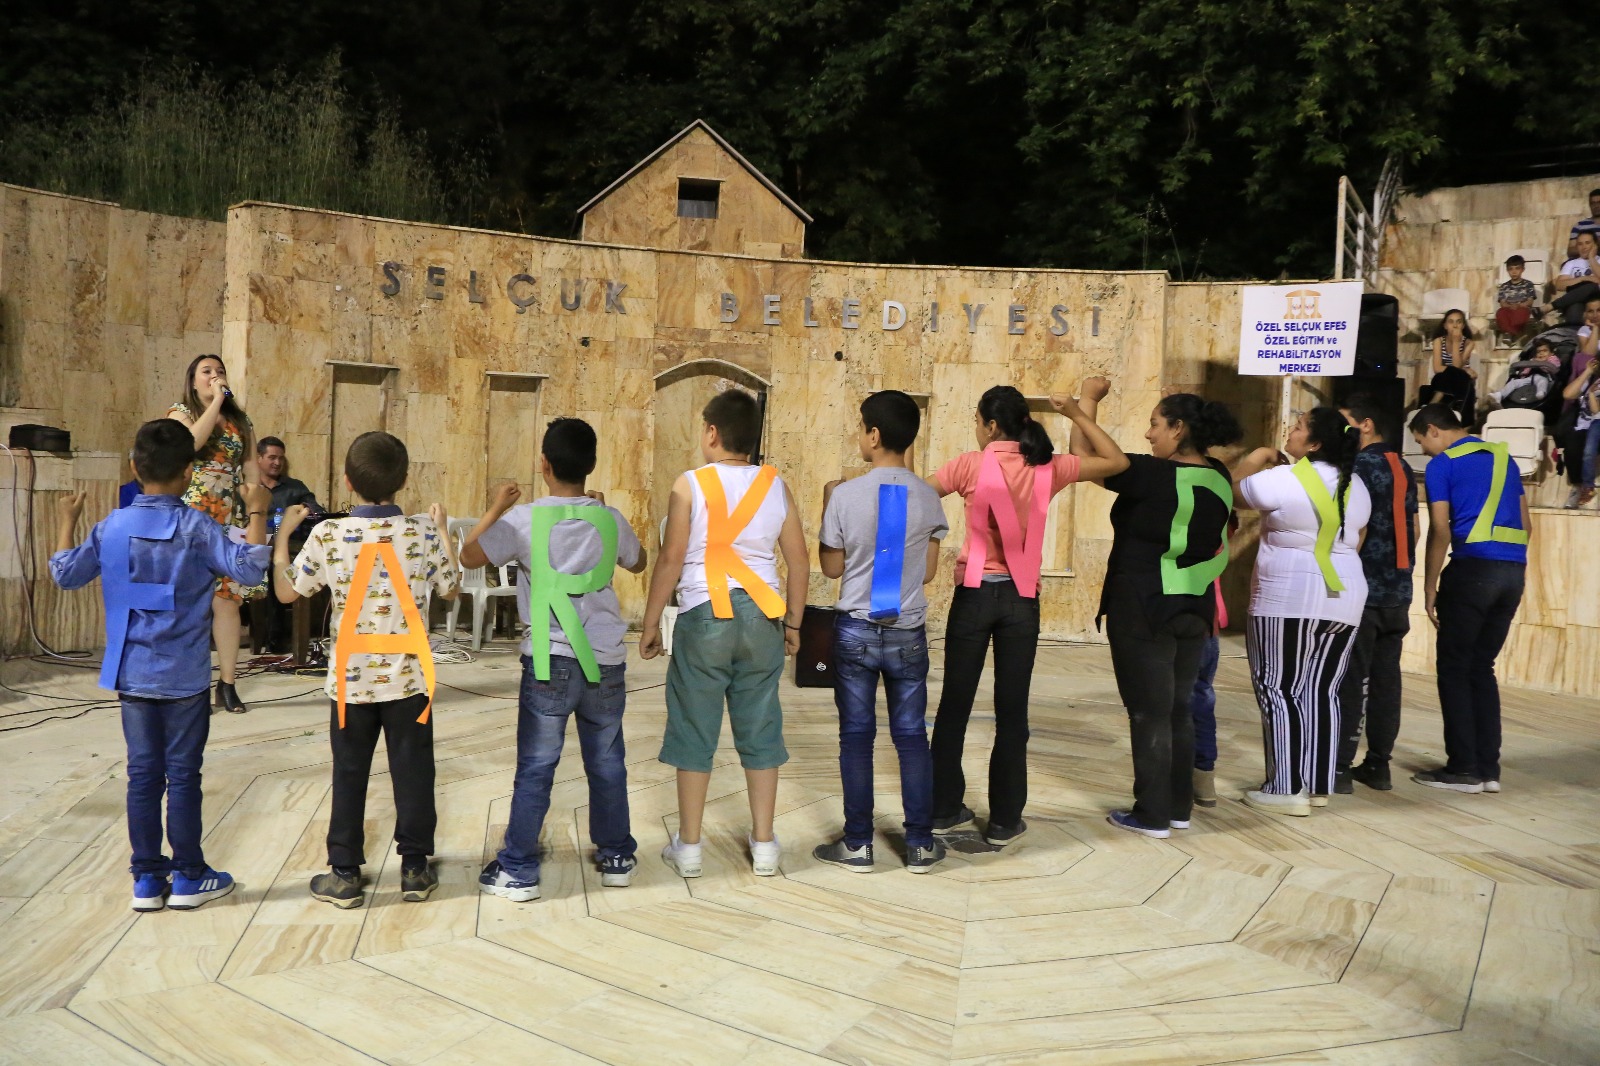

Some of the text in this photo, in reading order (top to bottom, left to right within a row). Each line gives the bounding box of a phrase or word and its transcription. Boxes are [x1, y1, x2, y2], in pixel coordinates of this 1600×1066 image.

[380, 260, 627, 315] SELÇUK
[1255, 321, 1347, 333] ÖZEL SELÇUK EFES
[1264, 334, 1290, 345] ÖZEL
[1327, 337, 1338, 345] ve
